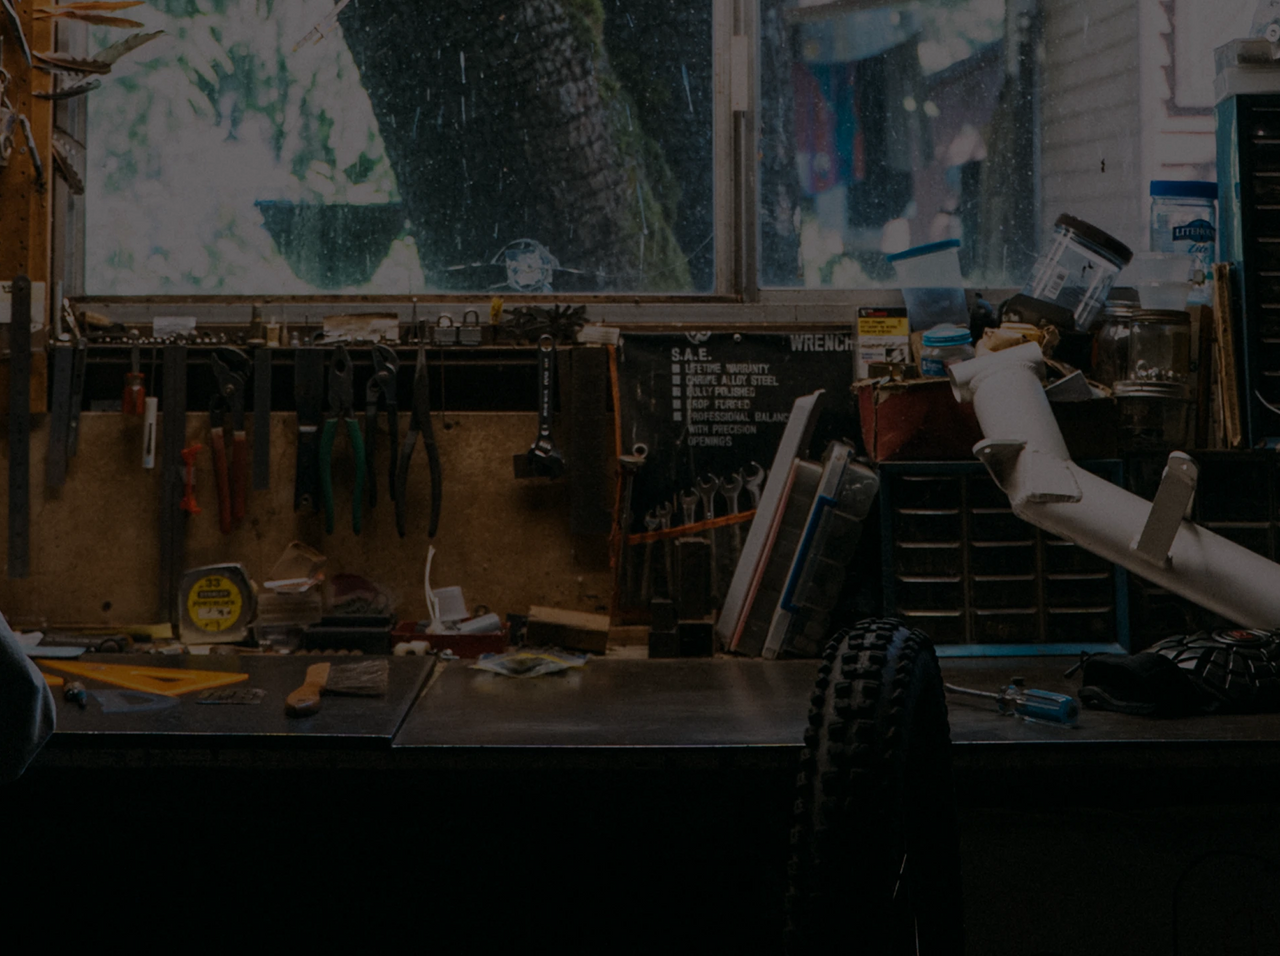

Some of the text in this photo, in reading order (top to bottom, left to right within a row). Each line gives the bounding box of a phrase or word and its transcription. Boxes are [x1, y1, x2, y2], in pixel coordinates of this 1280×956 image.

[671, 347, 713, 362] S.A.E.
[750, 376, 780, 387] STEEL
[714, 387, 756, 398] POLISHED
[688, 424, 757, 435] WITH PRECISION
[687, 436, 733, 447] OPENINGS
